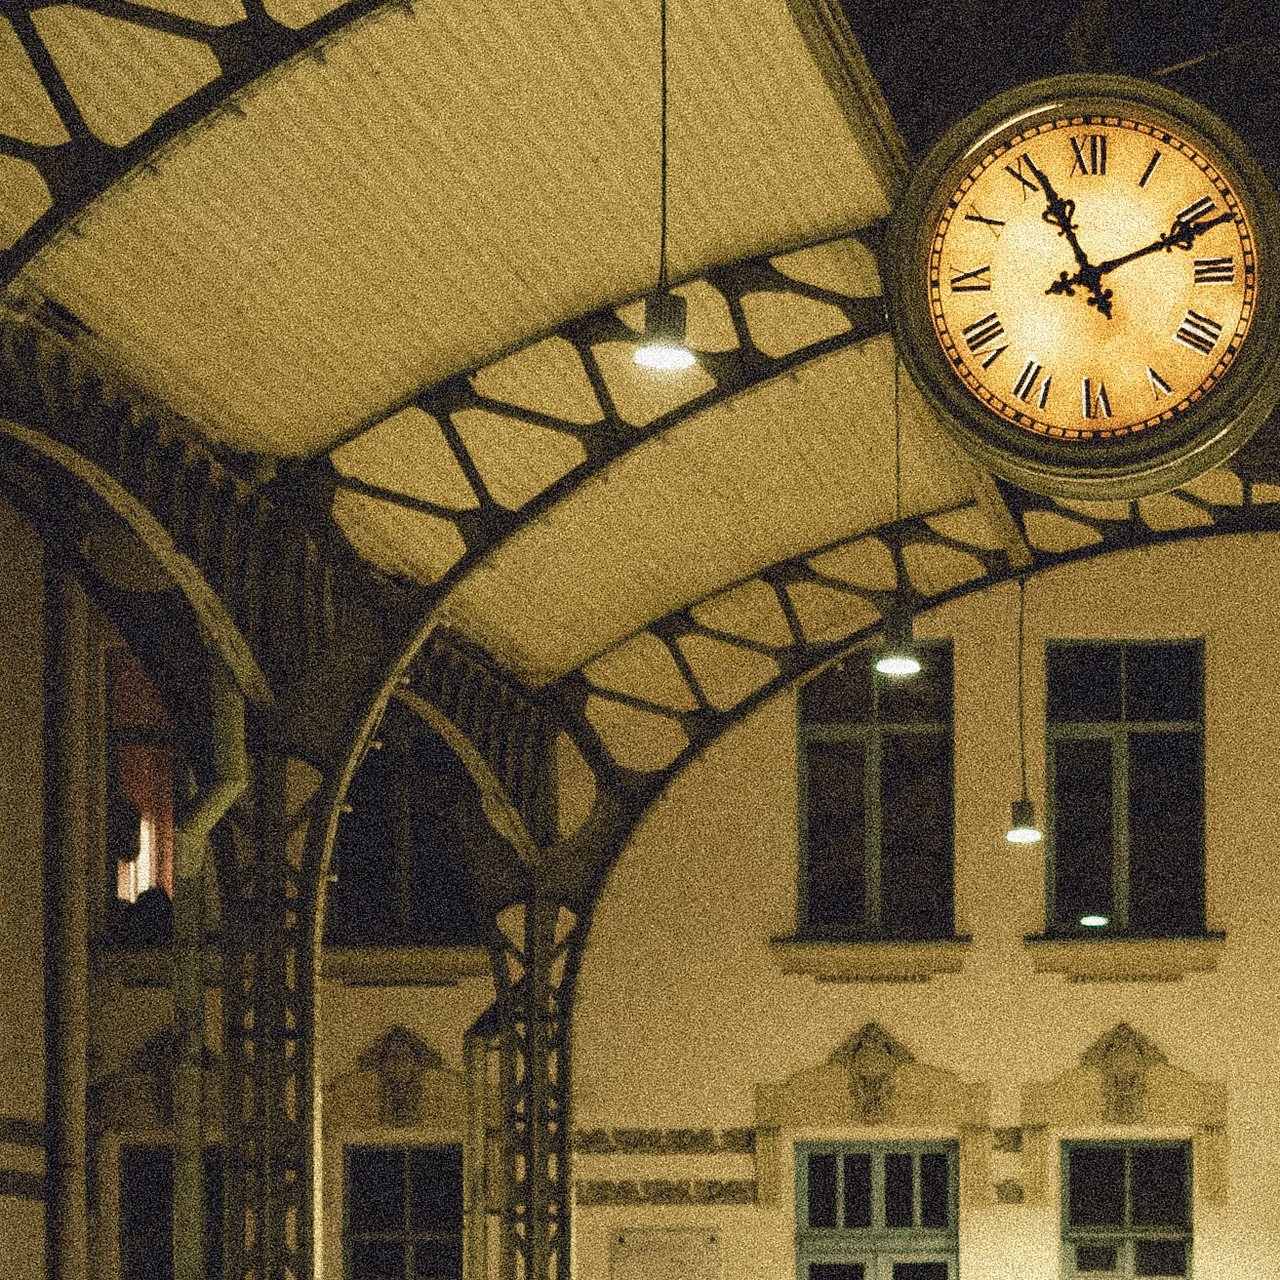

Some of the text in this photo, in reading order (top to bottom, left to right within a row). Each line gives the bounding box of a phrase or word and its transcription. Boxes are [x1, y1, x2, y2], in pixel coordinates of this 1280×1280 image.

[1070, 135, 1106, 177] XII
[1139, 150, 1163, 187] I
[965, 204, 1006, 237] X
[950, 265, 991, 293] IX
[1193, 256, 1235, 284] III
[962, 312, 1010, 370] VIII
[1175, 310, 1223, 356] IIII
[1012, 359, 1053, 410] VII
[1082, 376, 1113, 419] VI
[1146, 365, 1172, 401] V
